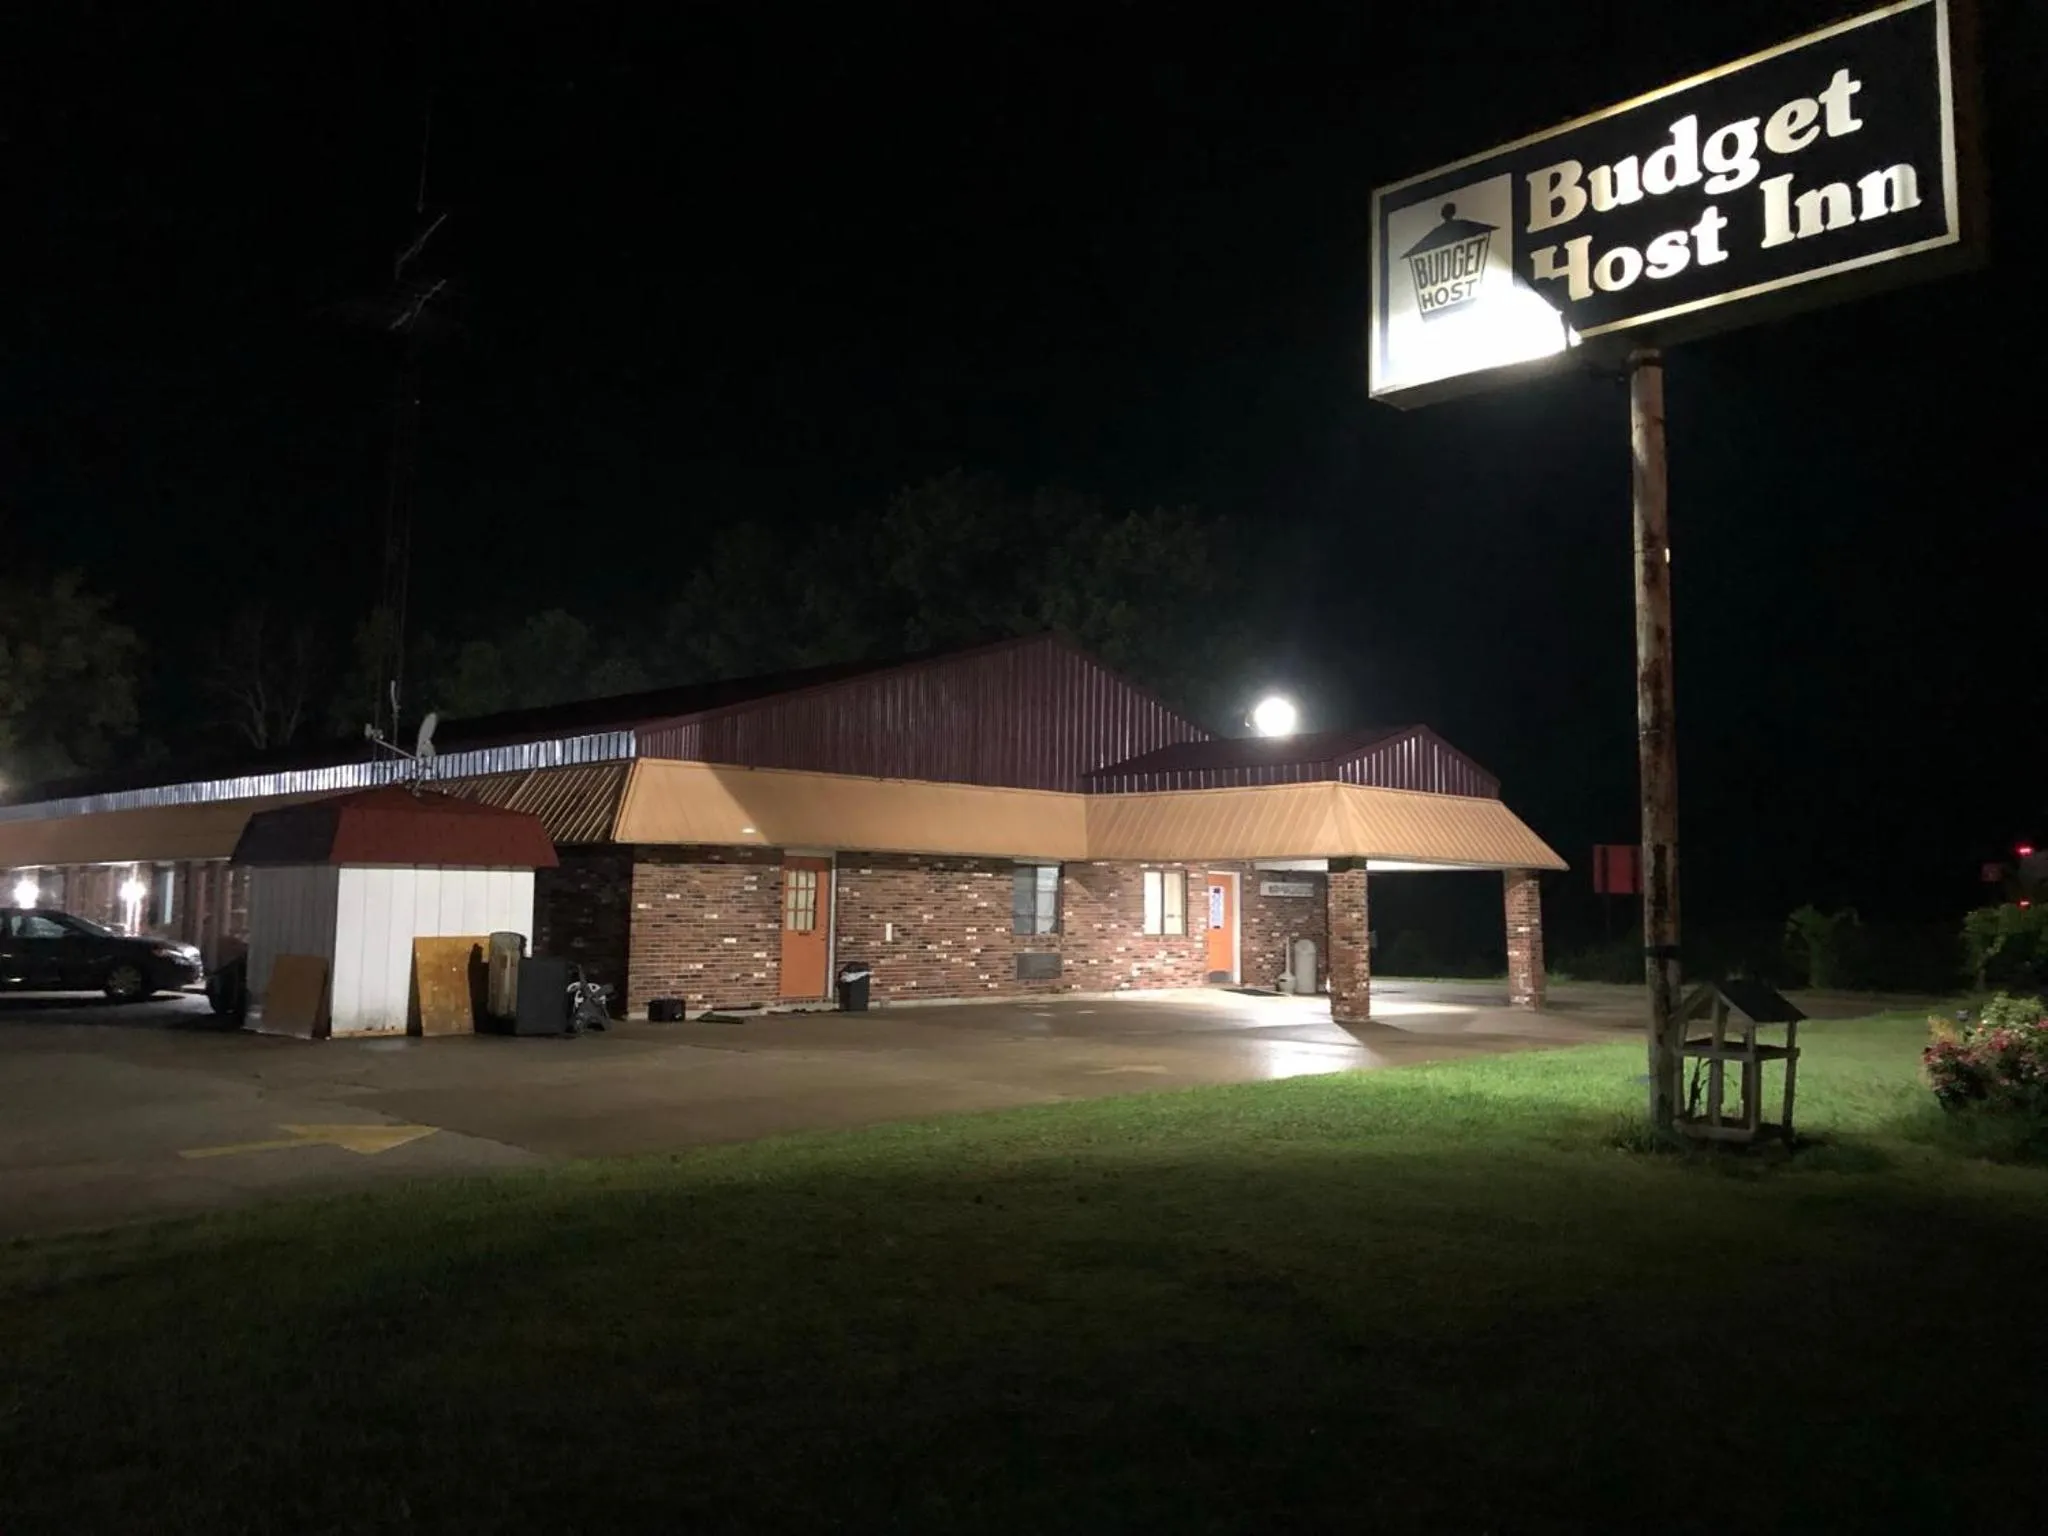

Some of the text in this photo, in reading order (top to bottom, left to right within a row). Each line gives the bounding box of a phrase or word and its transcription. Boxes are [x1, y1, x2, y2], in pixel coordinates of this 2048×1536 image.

[1525, 67, 1864, 234] Budget
[1414, 236, 1488, 290] BUDGET
[1530, 162, 1923, 302] Host Inn
[1421, 278, 1478, 309] HOST
